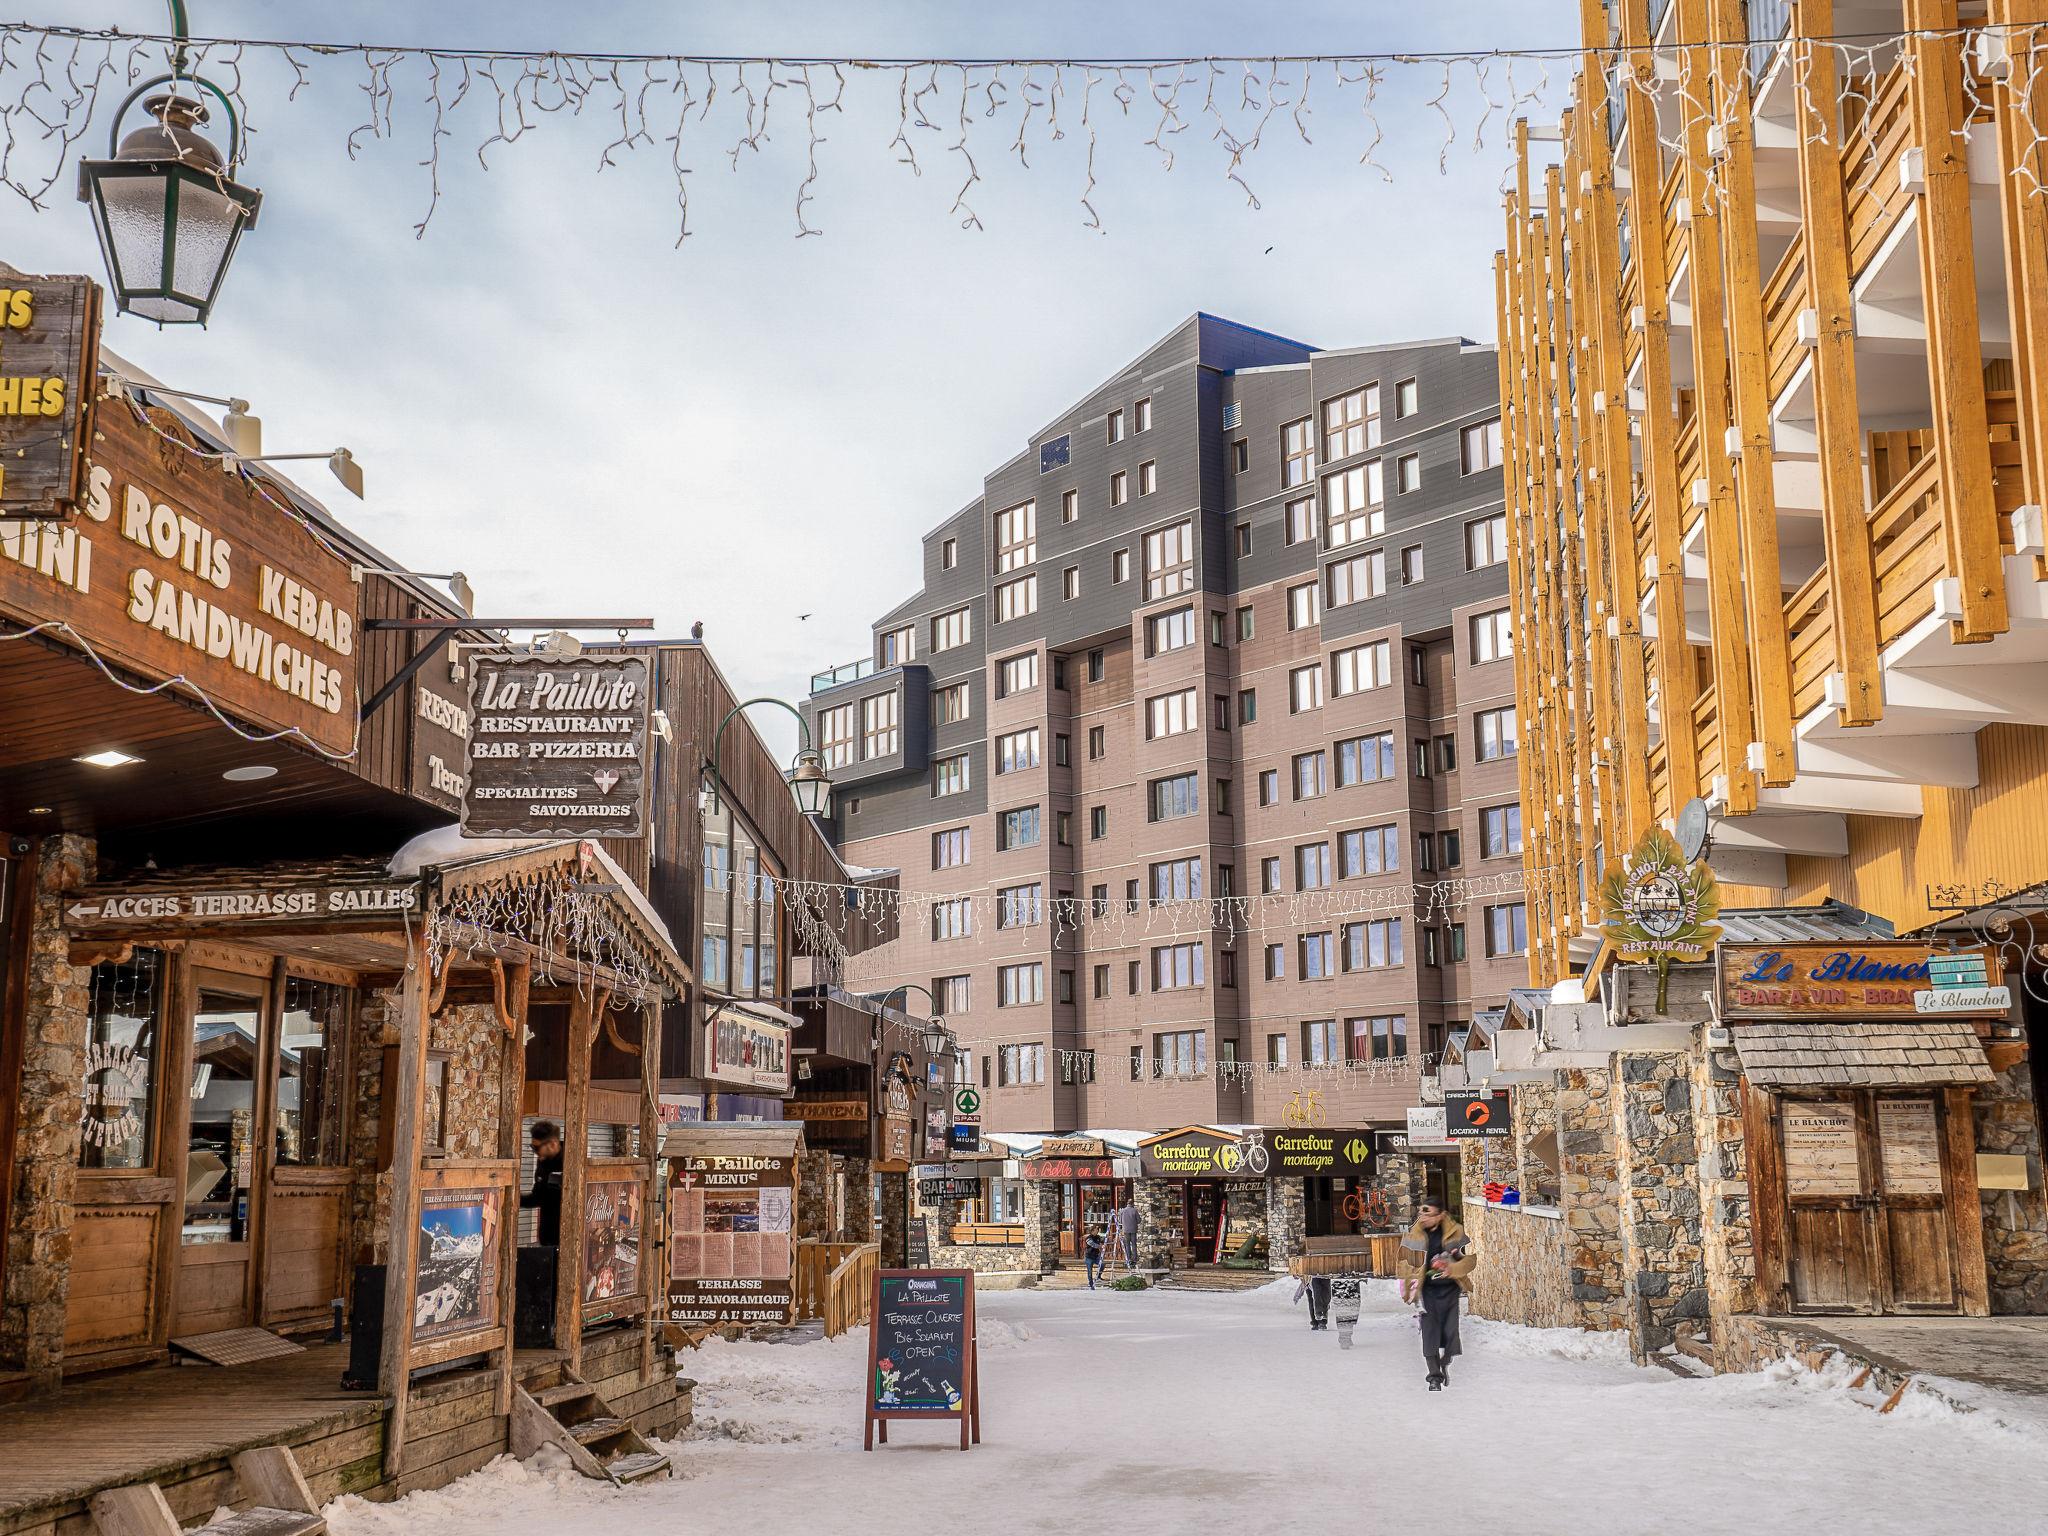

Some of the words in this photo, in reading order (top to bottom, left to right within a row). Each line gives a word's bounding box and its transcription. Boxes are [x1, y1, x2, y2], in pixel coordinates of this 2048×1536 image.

[121, 482, 233, 591] ROTIS
[259, 564, 353, 657] KEBAB
[127, 567, 343, 715] SANDWICHES
[480, 672, 522, 711] La
[530, 671, 637, 711] Paillote
[479, 717, 634, 733] RESTAURANT
[472, 743, 520, 759] BAR
[528, 742, 637, 758] PIZZERIA
[475, 787, 578, 799] SPECIALITES
[529, 804, 631, 816] SAVOYARDES
[1622, 862, 1659, 911] BLANCHOT
[1665, 864, 1690, 885] BAR
[101, 896, 180, 919] ACCES
[191, 892, 316, 917] TERRASSE
[328, 888, 417, 912] SALLES
[1622, 941, 1702, 954] RESTAURANT
[1742, 952, 1793, 982] Le
[1739, 989, 1782, 1005] BAR
[1790, 989, 1803, 1004] A
[1809, 989, 1846, 1005] VIN
[1918, 993, 1936, 1010] Le
[1941, 991, 2006, 1008] Blanchot
[1802, 1118, 1847, 1127] BLANCHOT
[1153, 1143, 1210, 1159] Carrefour
[1274, 1135, 1333, 1151] Carrefour
[684, 1158, 707, 1171] La
[713, 1157, 781, 1171] Paillote
[1162, 1160, 1211, 1176] montagne
[1283, 1153, 1334, 1171] montagne
[1077, 1166, 1093, 1177] en
[697, 1280, 762, 1290] TERRASSE
[670, 1294, 695, 1304] VUE
[699, 1294, 790, 1305] PANORAMIQUE
[897, 1291, 909, 1302] LA
[672, 1310, 716, 1320] SALLES
[720, 1310, 730, 1320] A
[743, 1309, 783, 1320] ETAGE
[906, 1346, 941, 1359] OPEN
